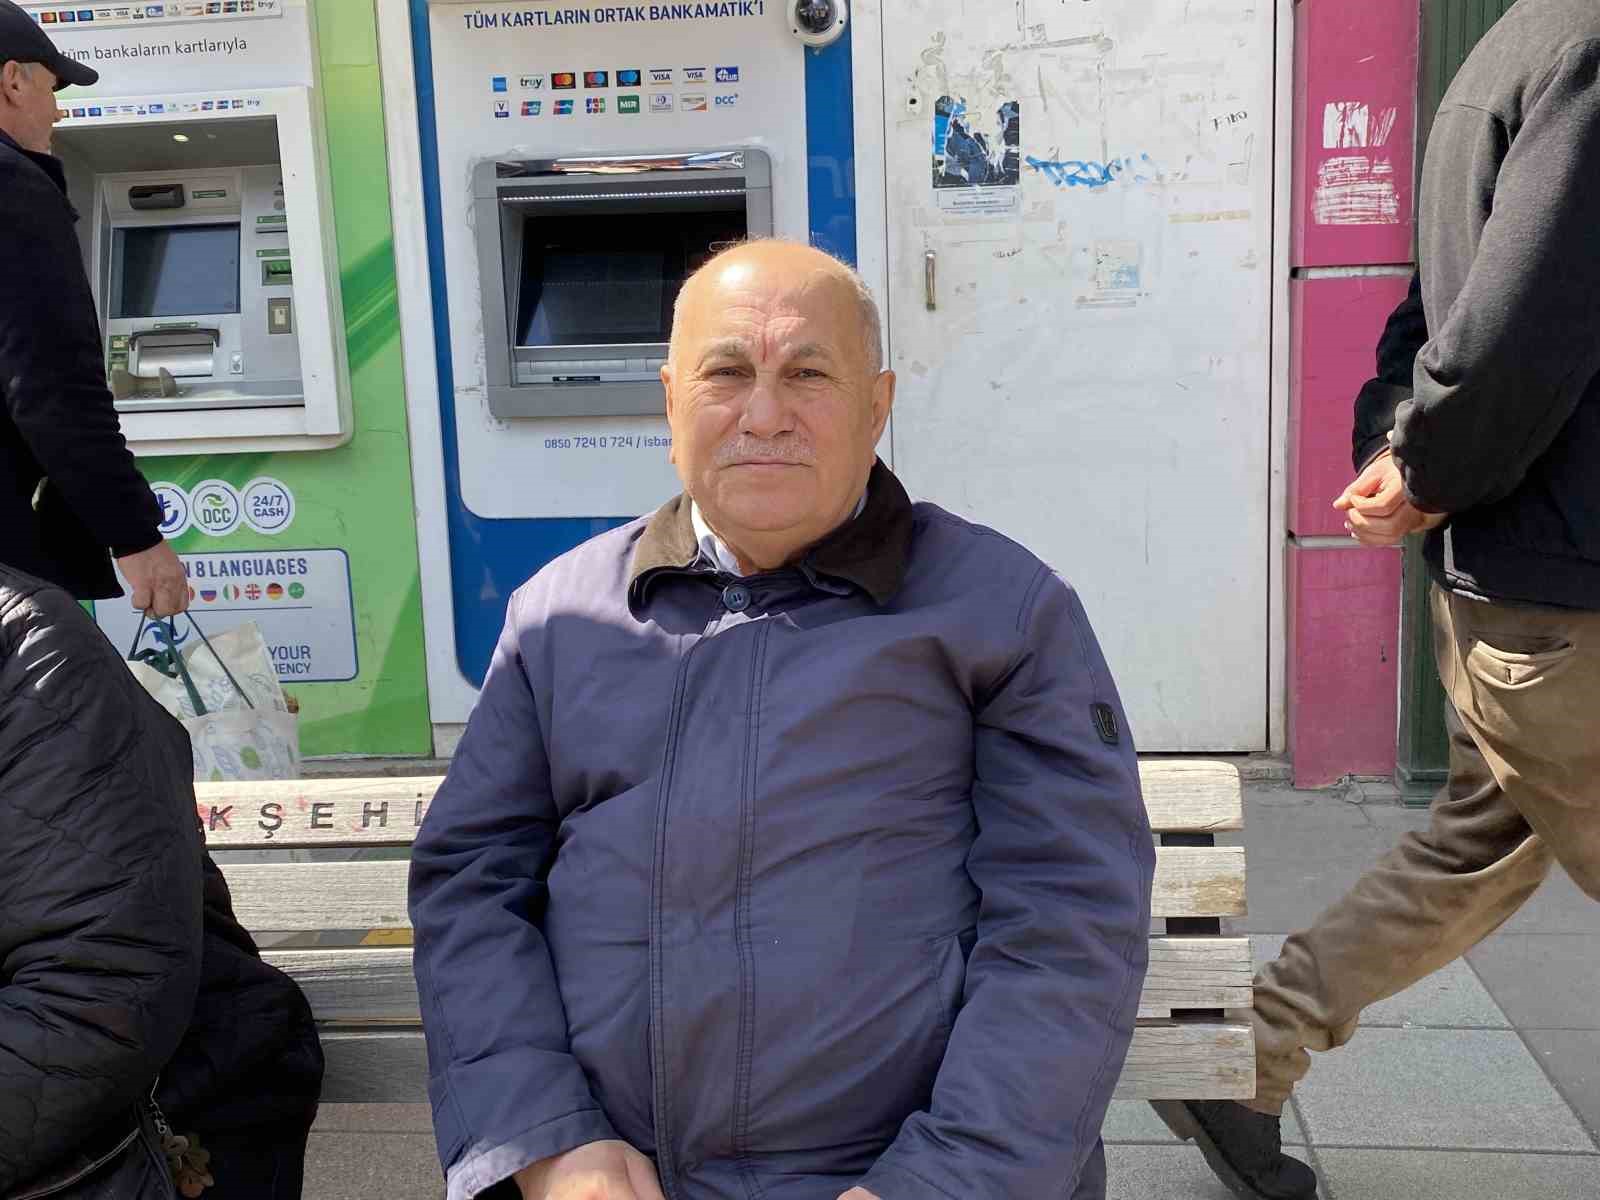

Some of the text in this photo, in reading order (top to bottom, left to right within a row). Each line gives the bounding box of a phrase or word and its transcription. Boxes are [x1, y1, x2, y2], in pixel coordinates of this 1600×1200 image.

[463, 11, 498, 29] TÜM
[501, 8, 591, 27] KARTLARIN
[594, 6, 646, 23] ORTAK
[94, 42, 171, 60] bankaların
[174, 36, 248, 55] kartlarıyla
[652, 73, 672, 81] VISA
[686, 71, 704, 79] VISA
[544, 438, 571, 449] 0850
[574, 436, 597, 449] 724
[610, 436, 633, 449] 724
[252, 495, 284, 507] 24/7
[202, 508, 232, 525] DCC
[253, 507, 285, 518] CASH
[195, 561, 206, 578] 8
[208, 558, 308, 578] LANGUAGES
[266, 645, 312, 660] YOUR
[208, 792, 424, 840] KŞEHİ
